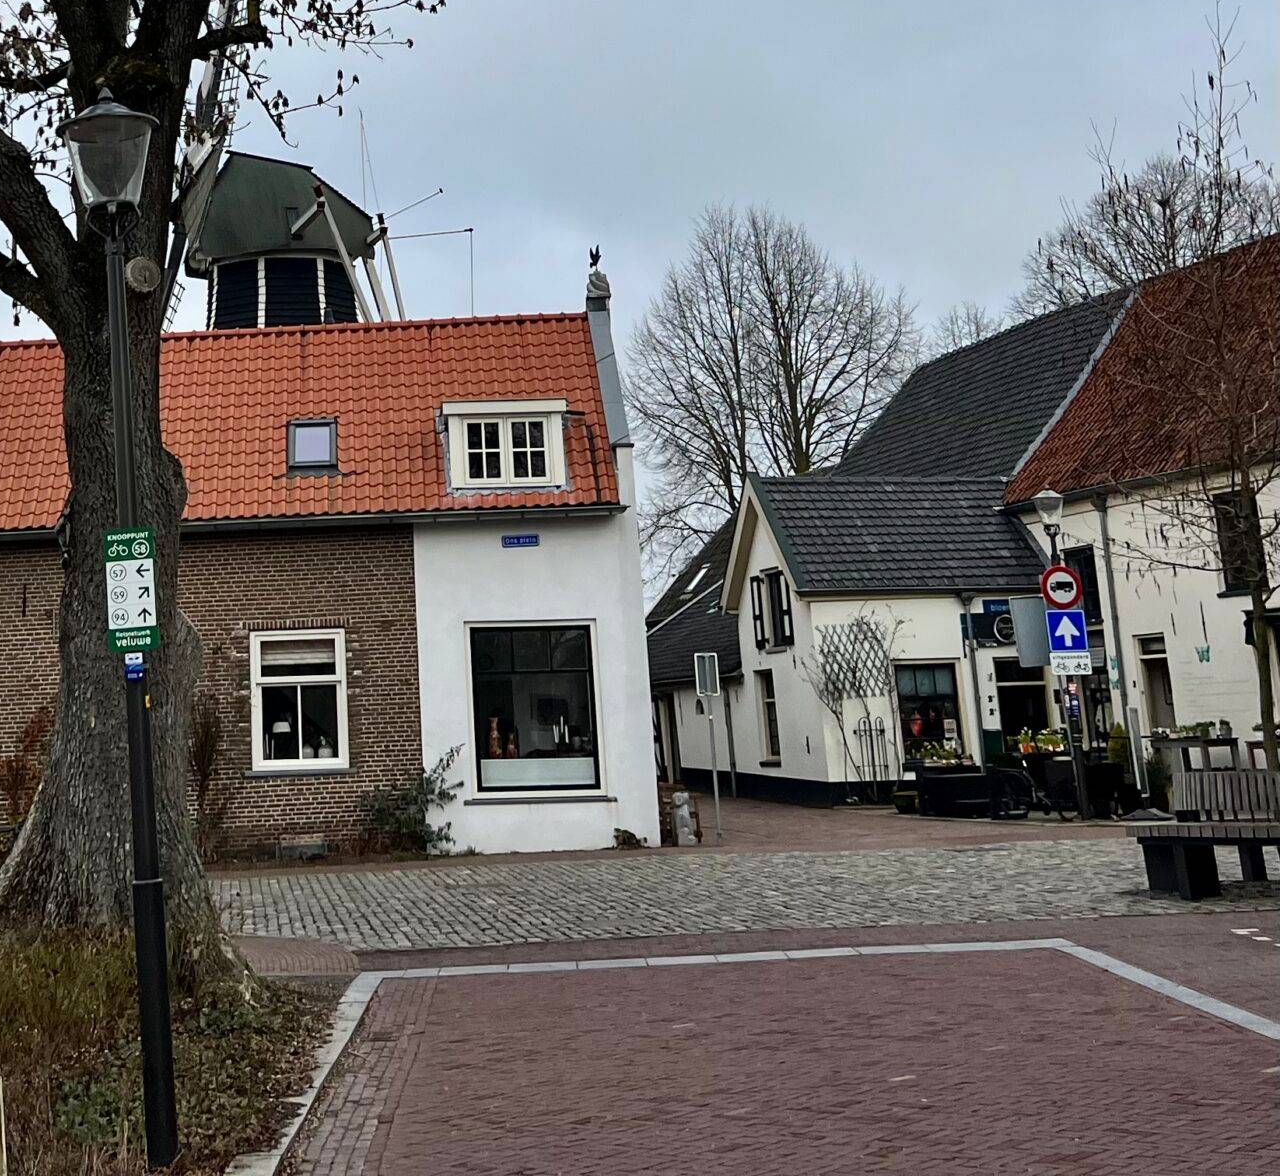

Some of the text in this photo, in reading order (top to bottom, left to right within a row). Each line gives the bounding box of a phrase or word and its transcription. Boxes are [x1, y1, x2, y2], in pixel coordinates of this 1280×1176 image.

[107, 531, 149, 542] KNOOPPUNT
[134, 544, 147, 554] 58
[112, 569, 124, 579] 57
[113, 590, 125, 600] 59
[114, 613, 126, 622] 94
[115, 636, 151, 647] veluwe
